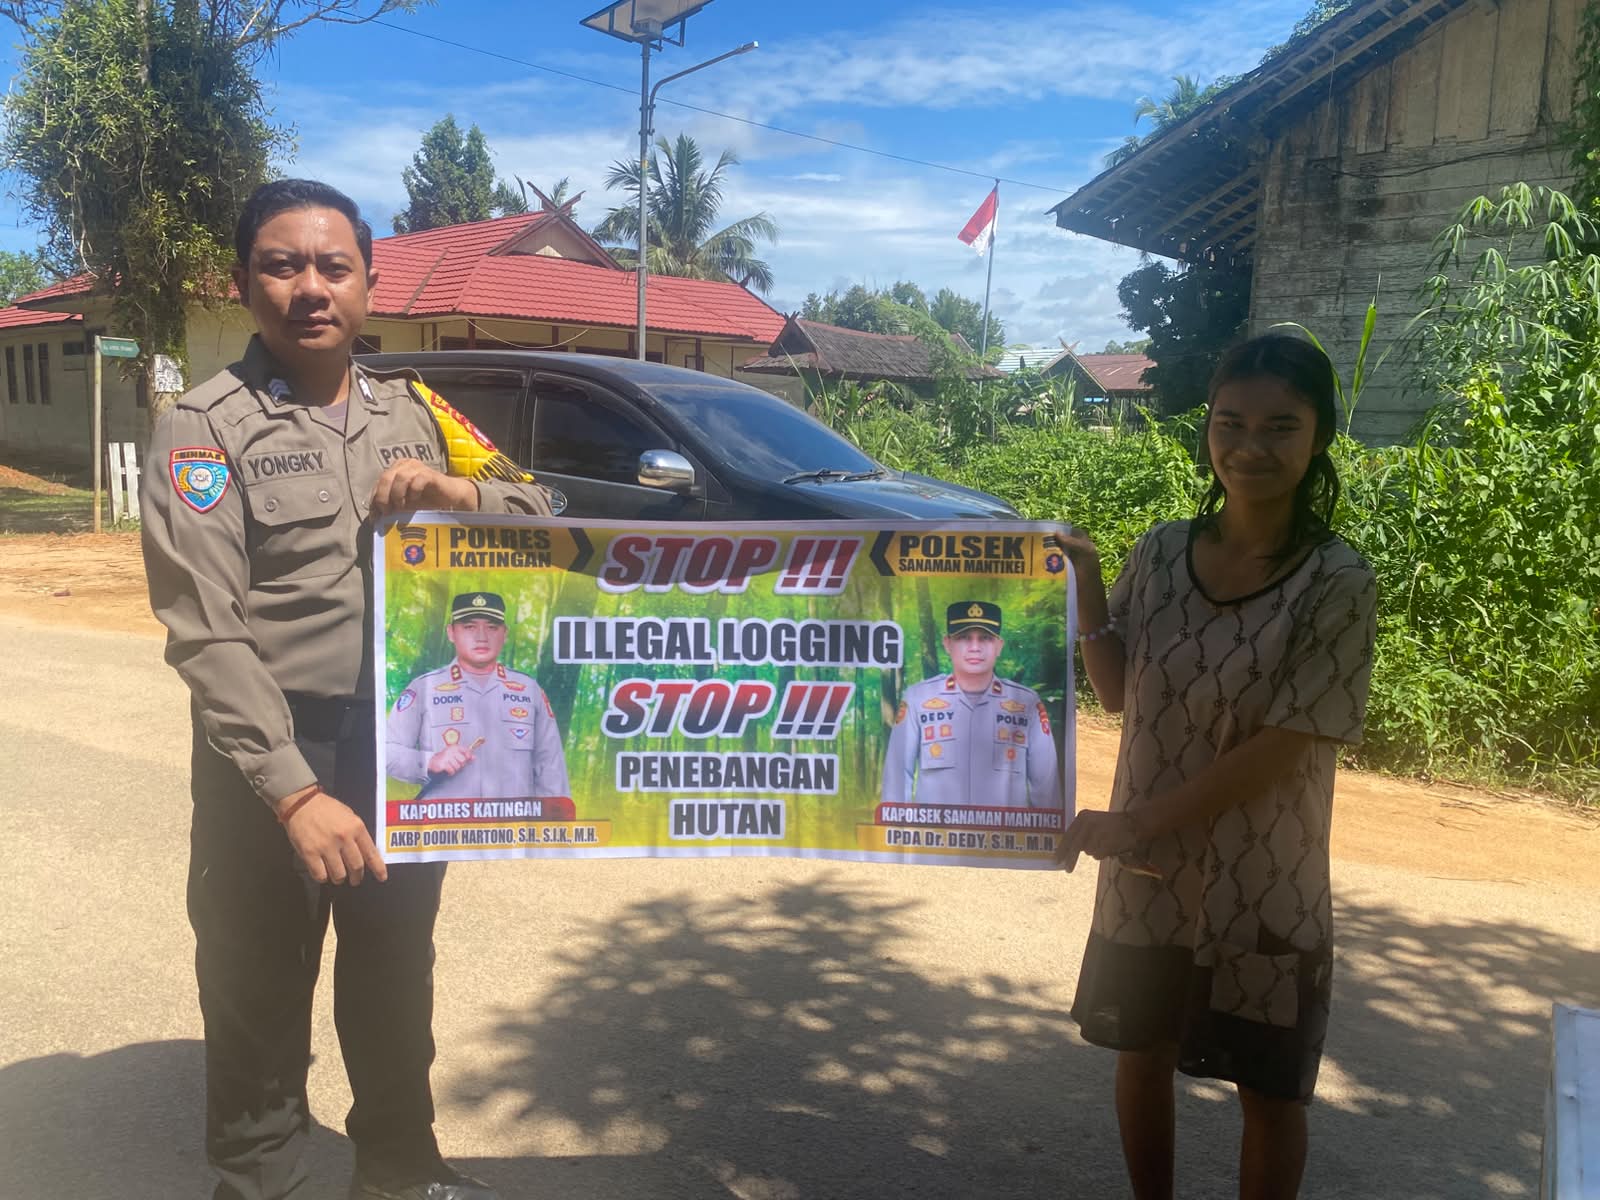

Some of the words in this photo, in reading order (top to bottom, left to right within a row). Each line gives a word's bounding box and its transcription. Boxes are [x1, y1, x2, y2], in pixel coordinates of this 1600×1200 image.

[247, 450, 325, 478] YONGKY
[379, 442, 434, 465] POLRI
[450, 527, 550, 549] POLRES
[900, 535, 1025, 559] POLSEK
[450, 551, 551, 568] KATINGAN
[603, 536, 777, 589] STOP
[778, 538, 862, 591] !!!
[898, 558, 961, 573] SANAMAN
[963, 560, 1025, 574] MANTIKEI
[556, 619, 713, 661] ILLEGAL
[721, 622, 901, 664] LOGGING
[432, 695, 463, 705] DODIK
[503, 693, 531, 704] POLRI
[604, 681, 773, 735] STOP
[774, 684, 853, 737] !!!
[920, 712, 954, 723] DEDY
[996, 714, 1028, 727] POLRI
[619, 755, 836, 791] PENEBANGAN
[399, 803, 471, 821] KAPOLRES
[473, 801, 542, 818] KATINGAN
[672, 803, 782, 837] HUTAN
[882, 806, 942, 824] KAPOLSEK
[943, 809, 1001, 826] SANAMAN
[1004, 811, 1062, 829] MANTIKEI
[390, 832, 421, 847] AKBP
[423, 831, 459, 846] DODIK
[460, 829, 517, 845] HARTONO,
[518, 827, 541, 843] S.H.,
[542, 827, 573, 843] S.I.K.,
[574, 827, 598, 842] M.H.
[887, 829, 922, 845] IPDA
[924, 832, 945, 847] Dr.
[990, 834, 1023, 851] S.H.,
